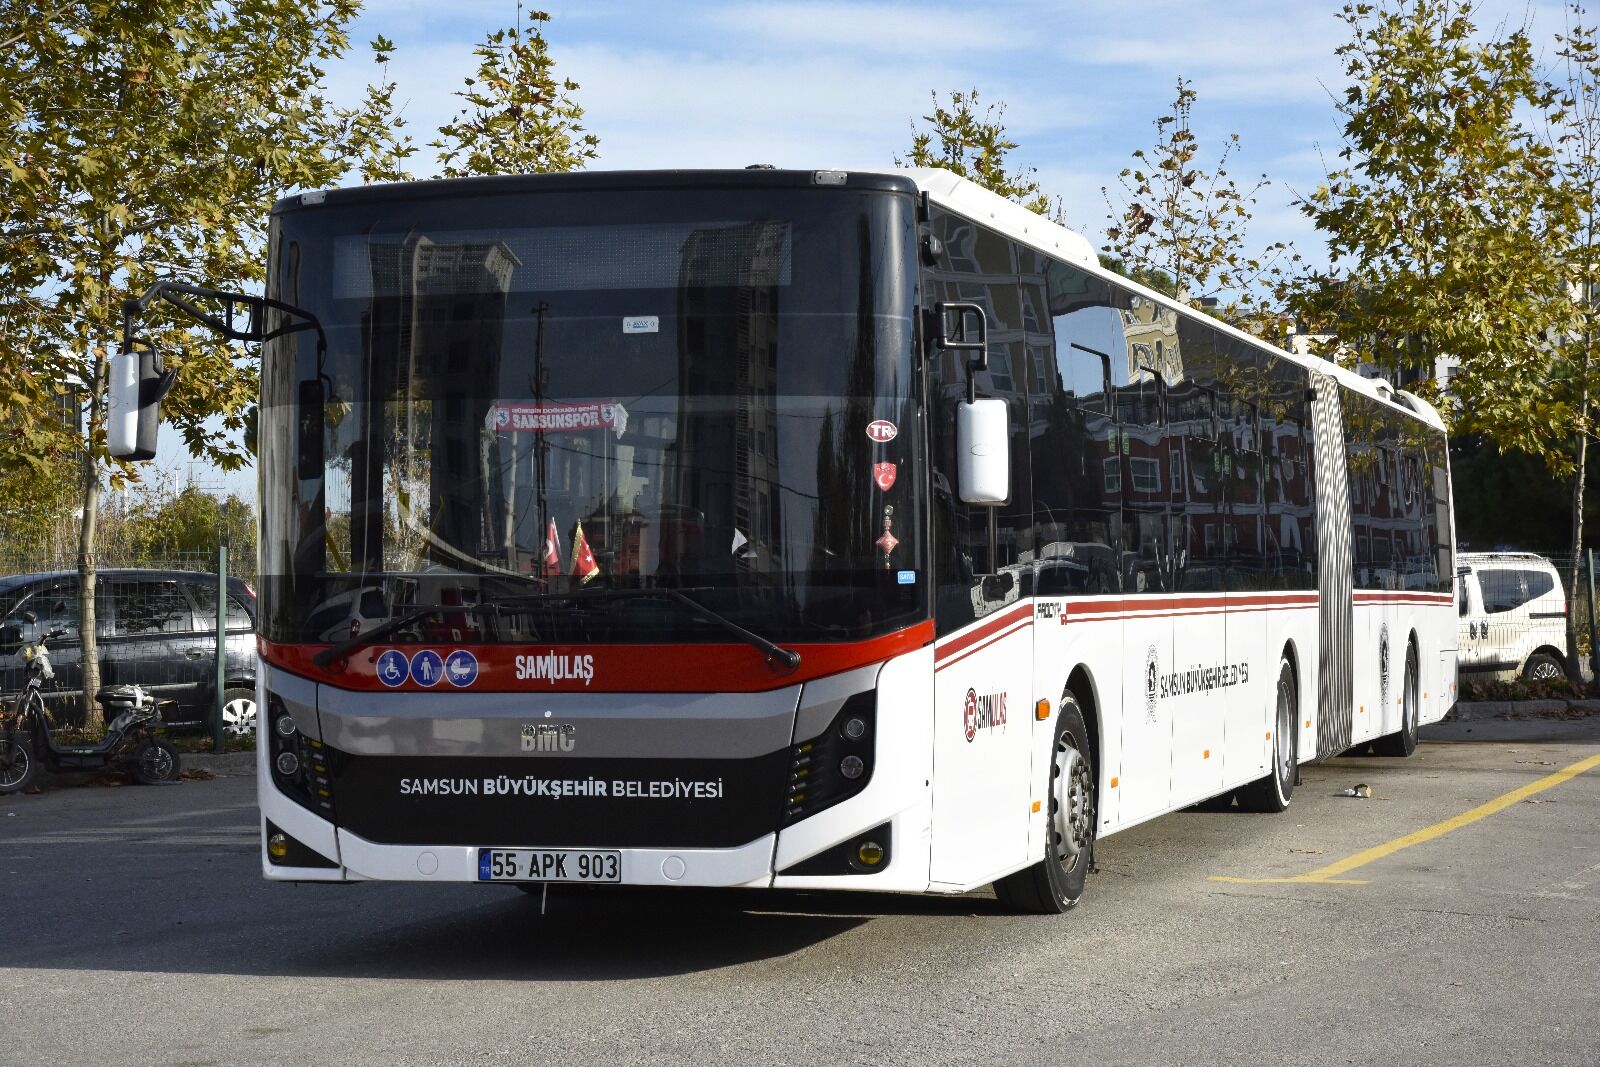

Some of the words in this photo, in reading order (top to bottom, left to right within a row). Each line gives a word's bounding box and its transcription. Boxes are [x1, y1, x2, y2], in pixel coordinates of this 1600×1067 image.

[512, 412, 600, 429] SAMSUNSPOR
[521, 724, 575, 752] BMC
[400, 778, 478, 795] SAMSUN
[483, 775, 608, 800] BÜYÜKŞEHİR
[612, 777, 724, 798] BELEDİYESİ
[492, 852, 517, 877] 55
[528, 853, 568, 878] APK
[578, 854, 618, 878] 903
